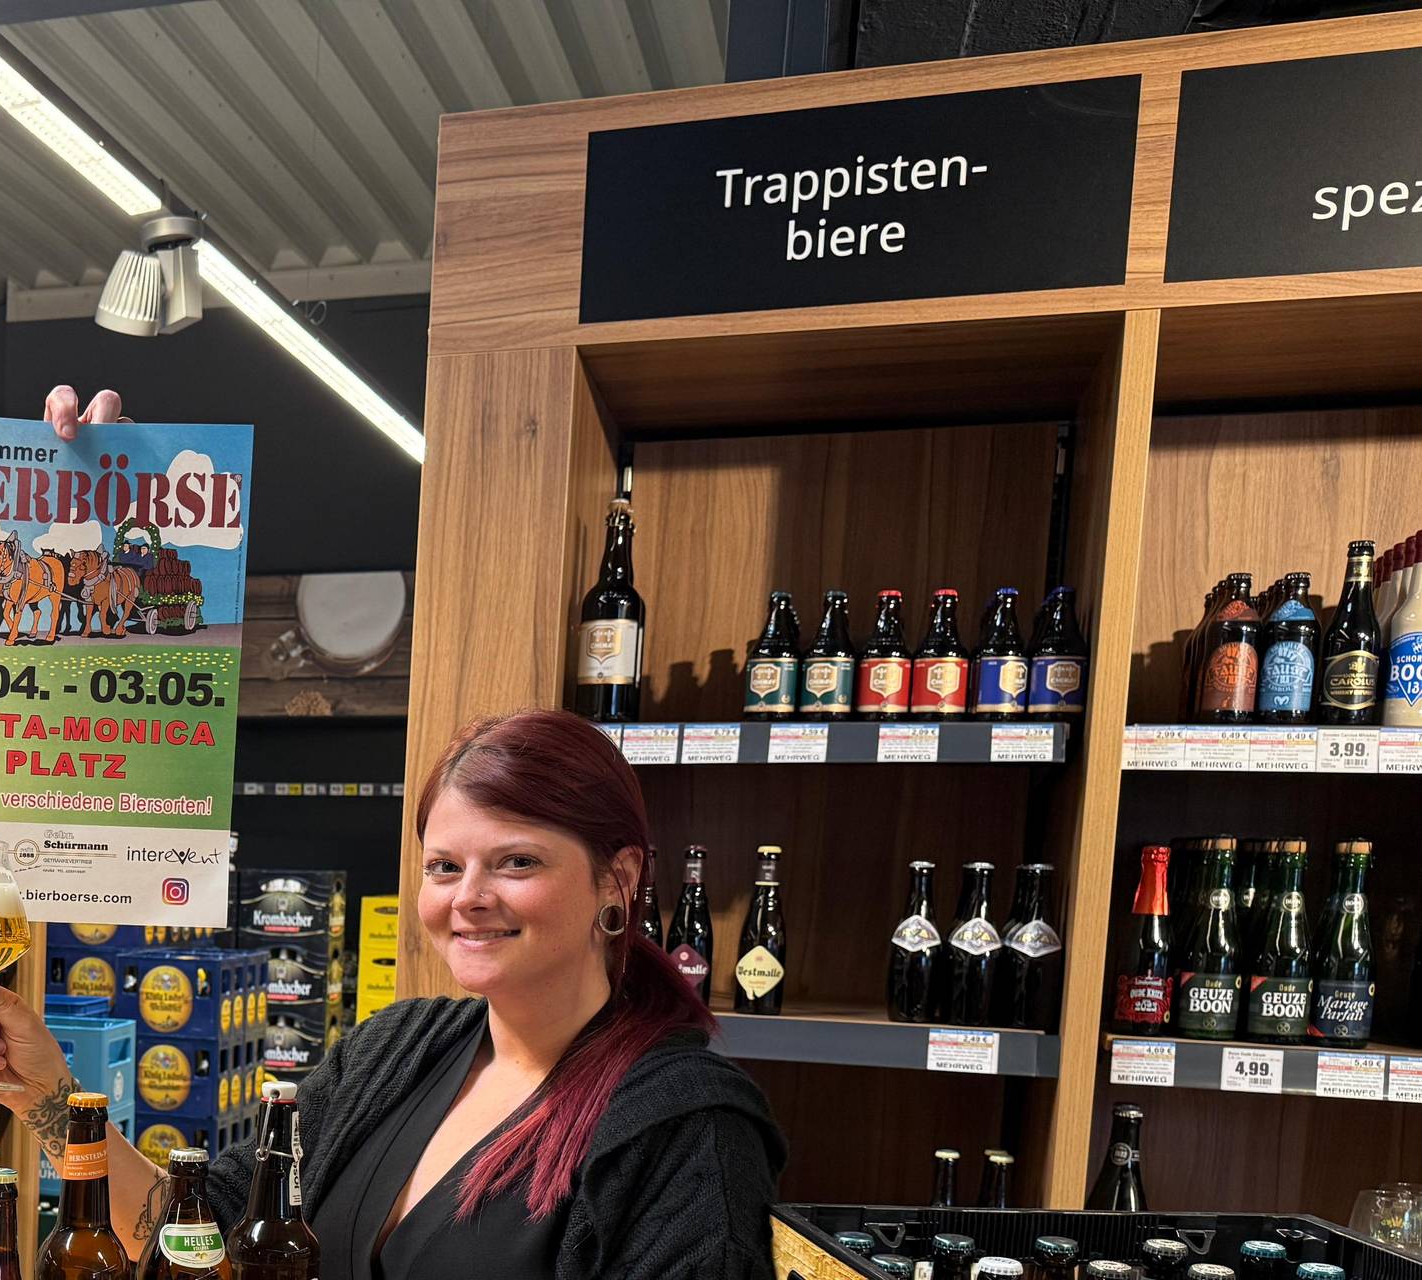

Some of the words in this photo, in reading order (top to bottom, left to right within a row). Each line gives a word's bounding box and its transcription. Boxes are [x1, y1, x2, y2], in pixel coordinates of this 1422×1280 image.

[716, 150, 989, 213] Trappisten-
[786, 219, 907, 262] biere
[64, 684, 78, 693] -
[90, 669, 226, 707] 03.05.
[1329, 743, 1366, 758] 3,99
[5, 749, 127, 779] PLATZ
[1127, 760, 1178, 768] MEHRWEG
[1190, 761, 1243, 769] MEHRWEG
[1255, 762, 1309, 770] MEHRWEG
[0, 789, 114, 812] verschiedene
[119, 793, 212, 815] Biersorten!
[44, 841, 109, 851] Schürmann
[19, 890, 132, 904] .bierboerse.com
[253, 910, 314, 927] Krombacher
[268, 979, 312, 995] mbacher
[1189, 987, 1234, 1000] GEUZE
[1261, 992, 1307, 1005] GEUZE
[1317, 995, 1369, 1011] Mariage
[1189, 1000, 1232, 1013] BOON
[1261, 1003, 1306, 1018] BOON
[1321, 1007, 1365, 1022] Parfait
[936, 1061, 983, 1071] MEHRWEG
[1235, 1061, 1271, 1077] 4,99
[1117, 1073, 1168, 1084] MEHRWEG
[1323, 1086, 1377, 1098] MEHRWEG
[184, 1236, 214, 1247] HELLES
